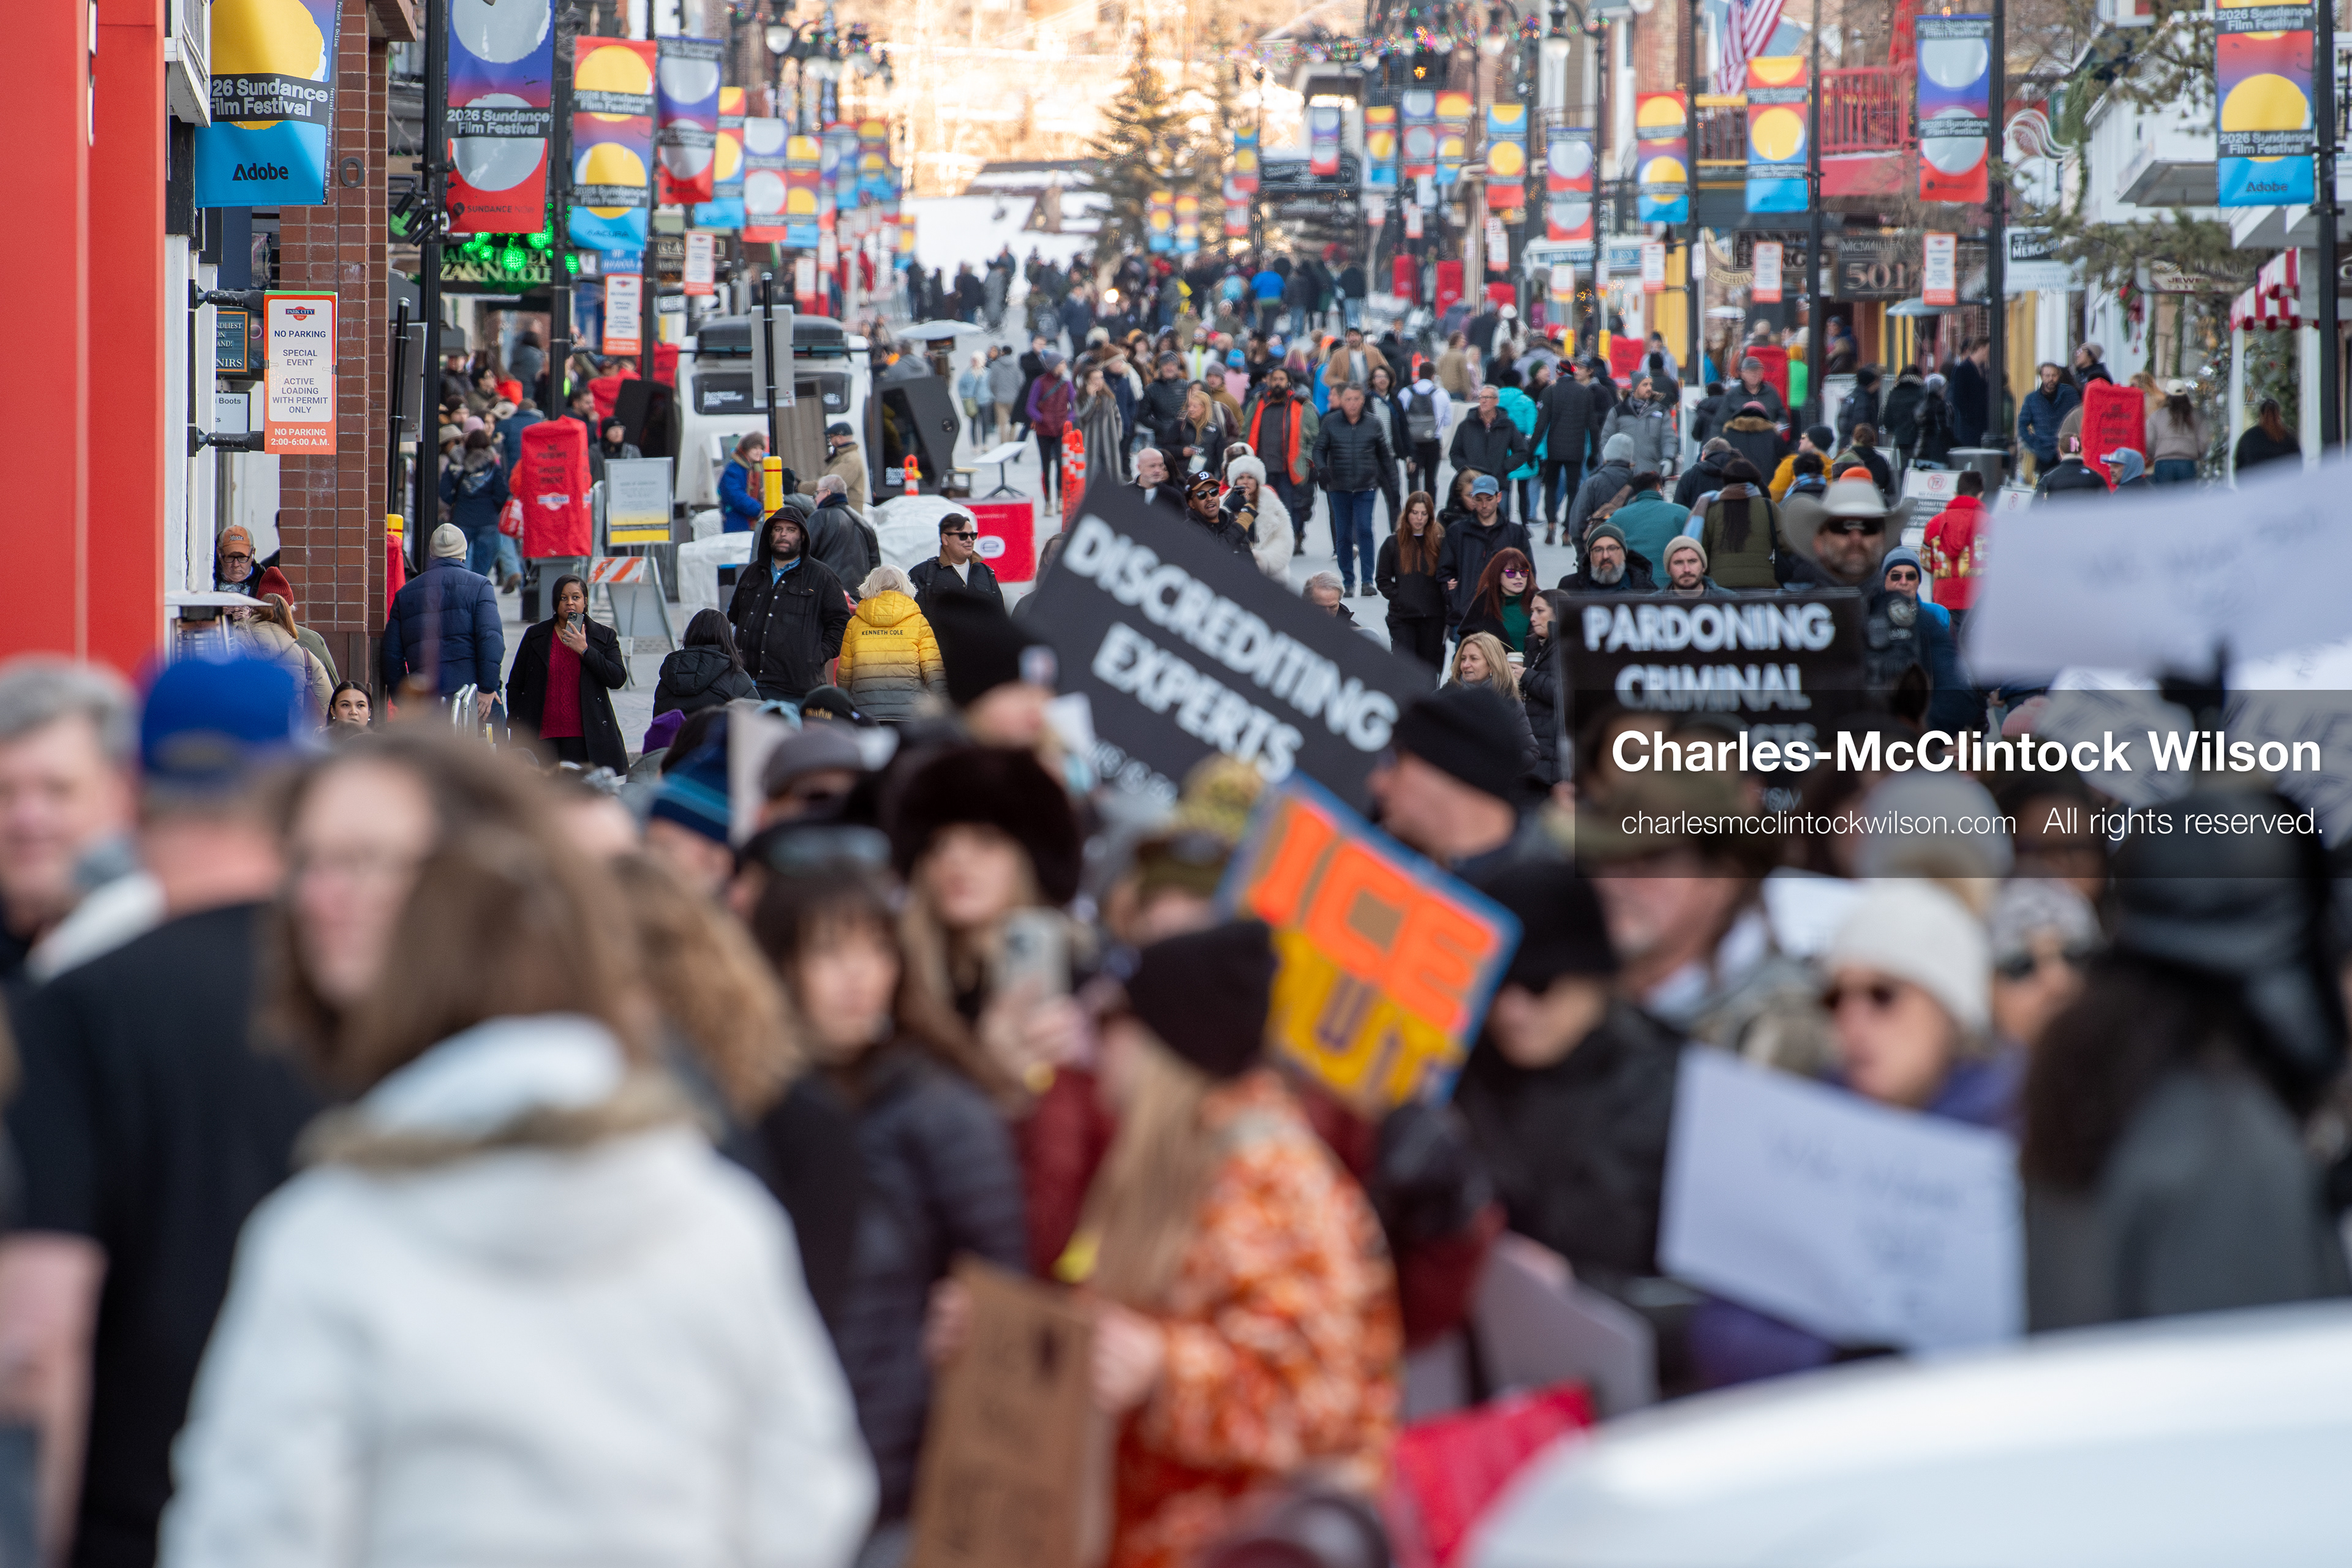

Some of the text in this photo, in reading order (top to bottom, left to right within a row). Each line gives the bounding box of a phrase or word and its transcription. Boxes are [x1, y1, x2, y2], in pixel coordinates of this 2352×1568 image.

[2217, 6, 2313, 21] 2026 Sundance
[2227, 17, 2304, 31] Film Festival
[210, 78, 328, 103] 26 Sundance
[244, 96, 312, 117] Festival
[447, 109, 551, 123] 2026 Sundance
[458, 122, 540, 134] Film Festival
[2219, 132, 2313, 145] 2026 Sundance
[2230, 143, 2305, 154] Film Festival
[232, 162, 288, 181] Adobe
[2247, 181, 2288, 192] Adobe
[467, 205, 513, 213] SUNDANCE
[1844, 263, 1905, 290] 501
[217, 358, 243, 368] NIRS
[1061, 514, 1400, 752] DISCREDITING
[1582, 603, 1836, 652] PARDONING
[1615, 663, 1812, 712] CRIMINAL
[1091, 621, 1305, 783] EXPERTS
[1246, 800, 1502, 1035] ICE
